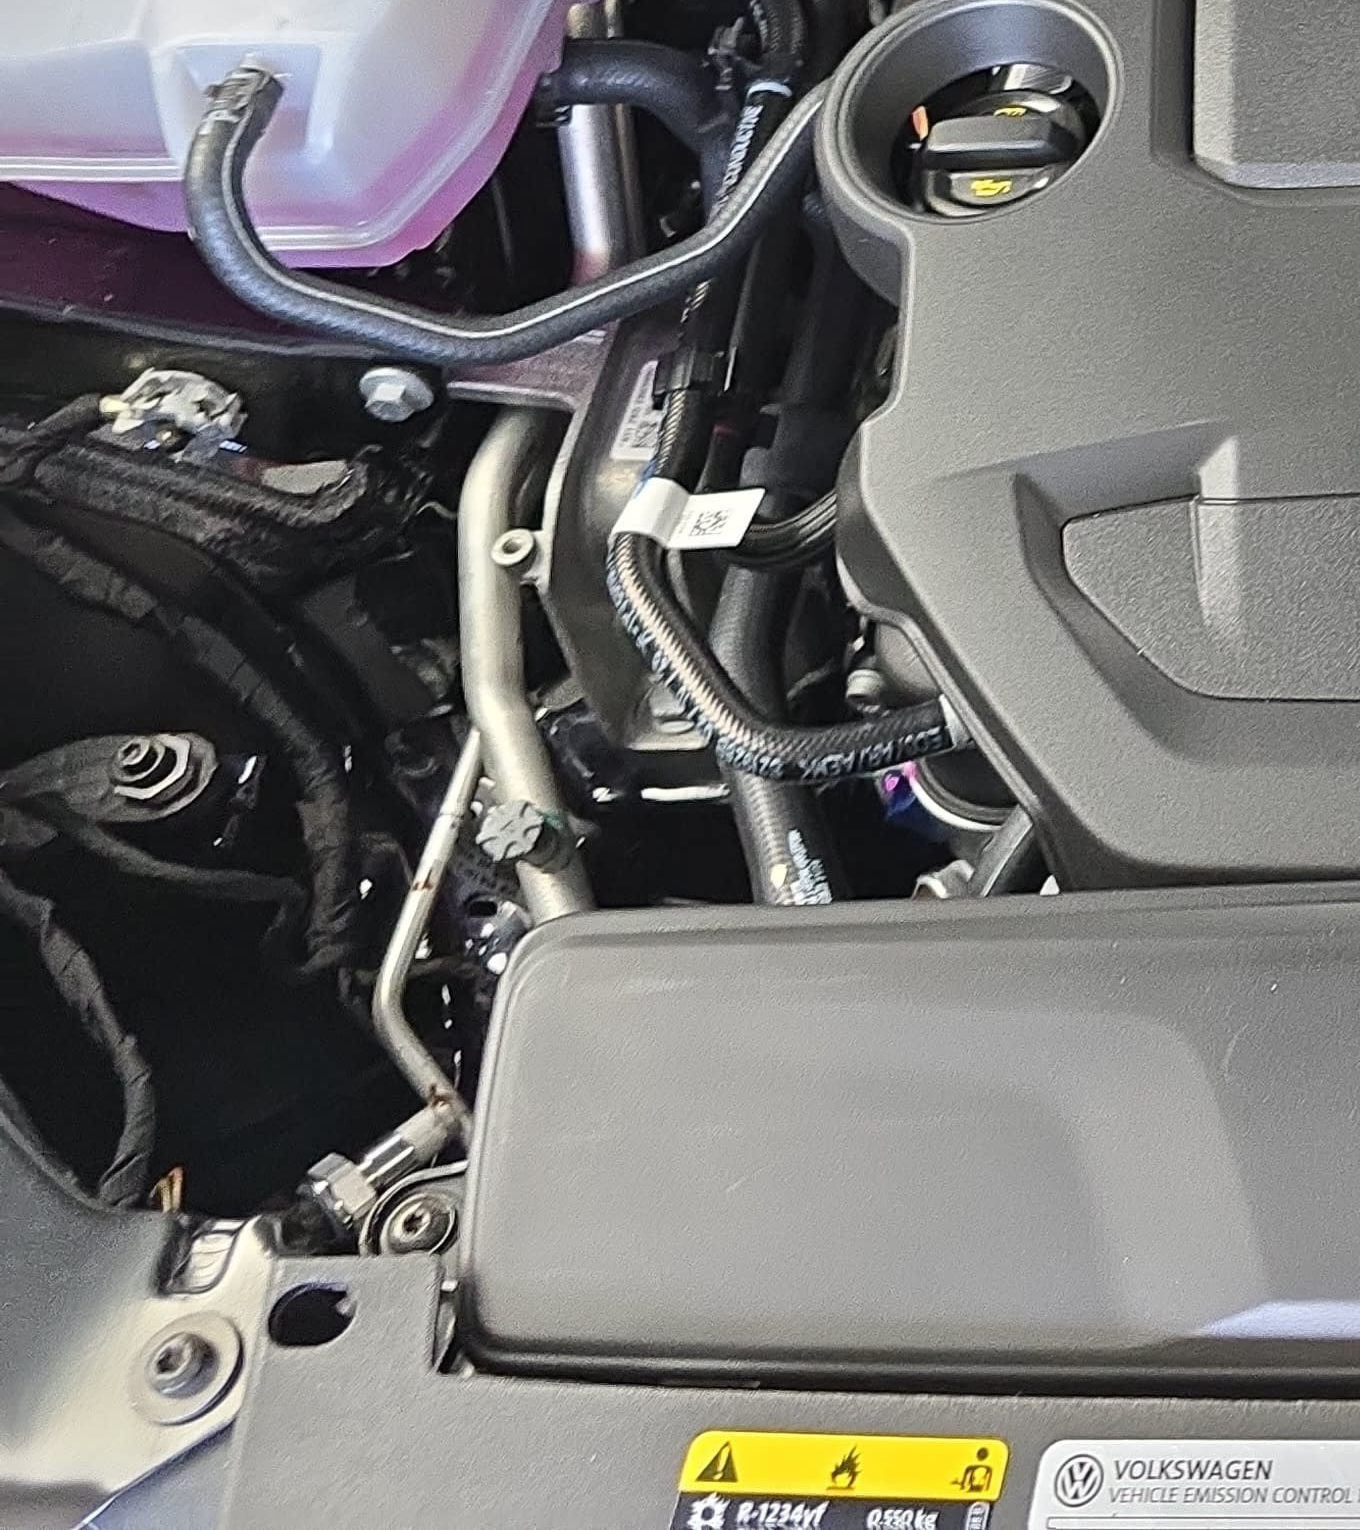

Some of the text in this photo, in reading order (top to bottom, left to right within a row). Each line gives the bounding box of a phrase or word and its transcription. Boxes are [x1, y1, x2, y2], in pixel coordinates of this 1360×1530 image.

[1113, 1460, 1274, 1480] VOLKSWAGEN
[1109, 1486, 1180, 1504] VEHICLE
[1182, 1487, 1268, 1504] EMISSION
[1272, 1487, 1351, 1504] CONTROL
